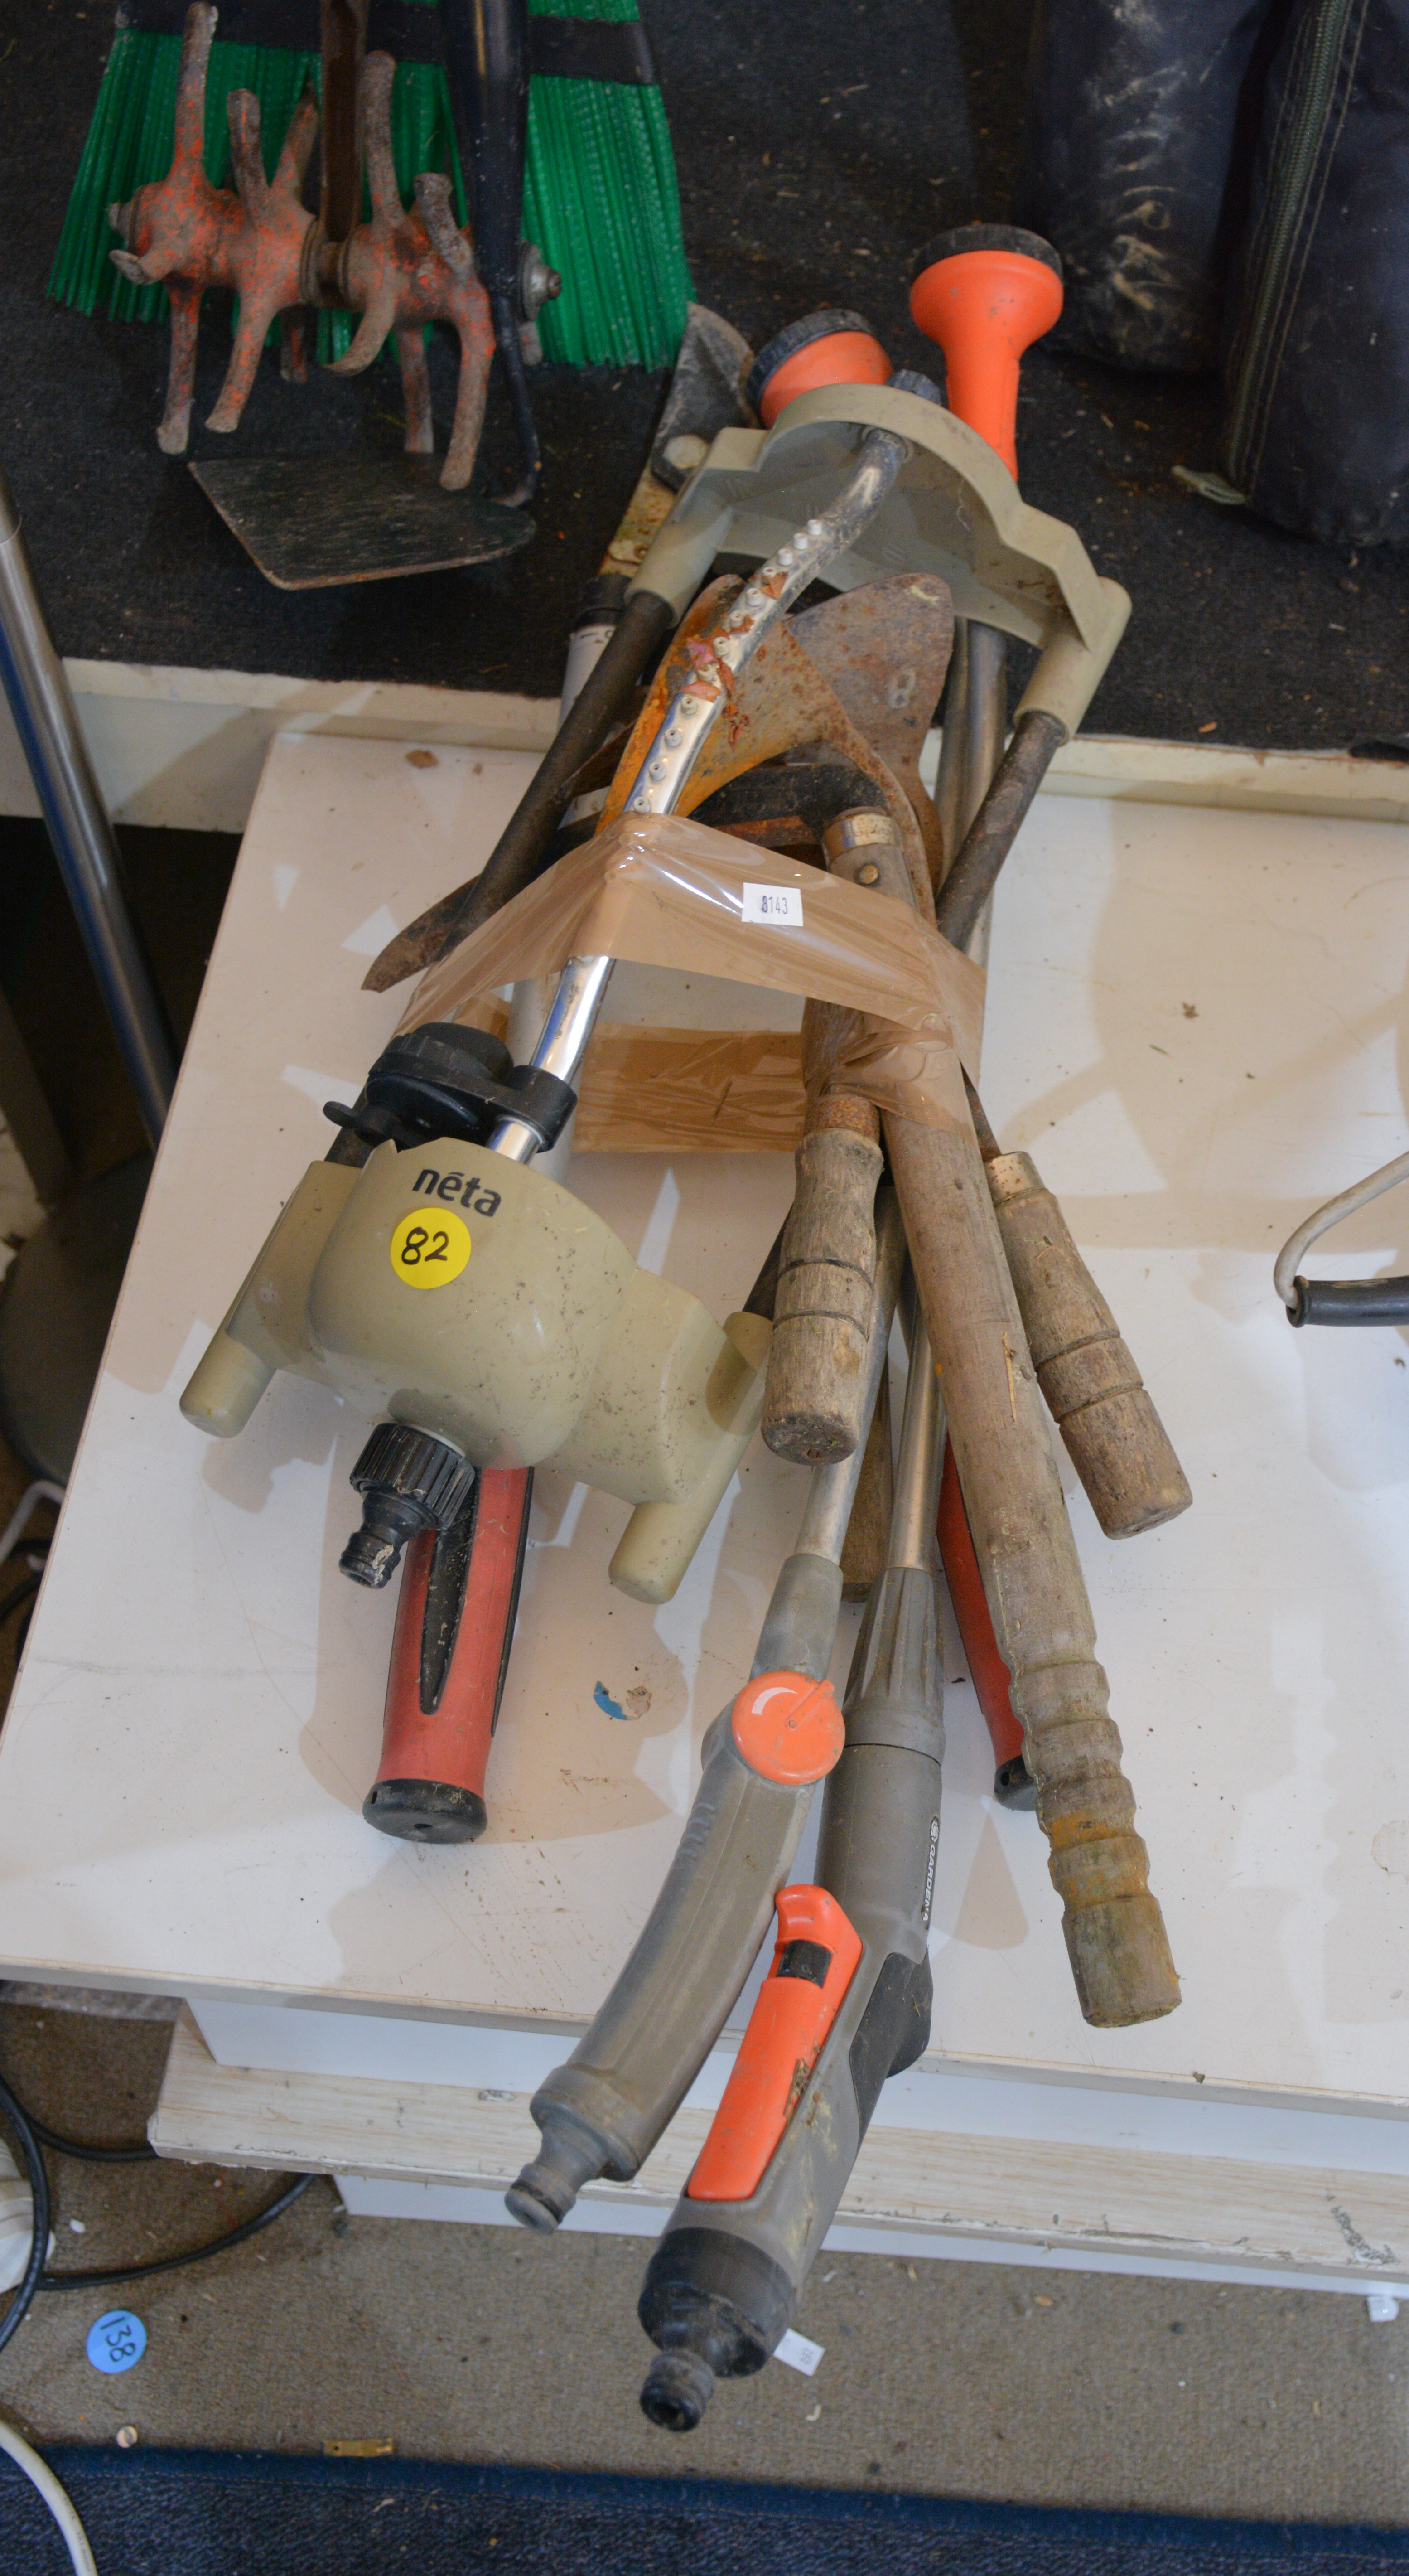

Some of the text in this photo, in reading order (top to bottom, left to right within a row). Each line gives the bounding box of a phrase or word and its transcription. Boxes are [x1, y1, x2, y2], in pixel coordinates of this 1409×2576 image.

[761, 896, 788, 914] 8143
[401, 1226, 449, 1265] 82
[100, 2317, 135, 2362] 138
